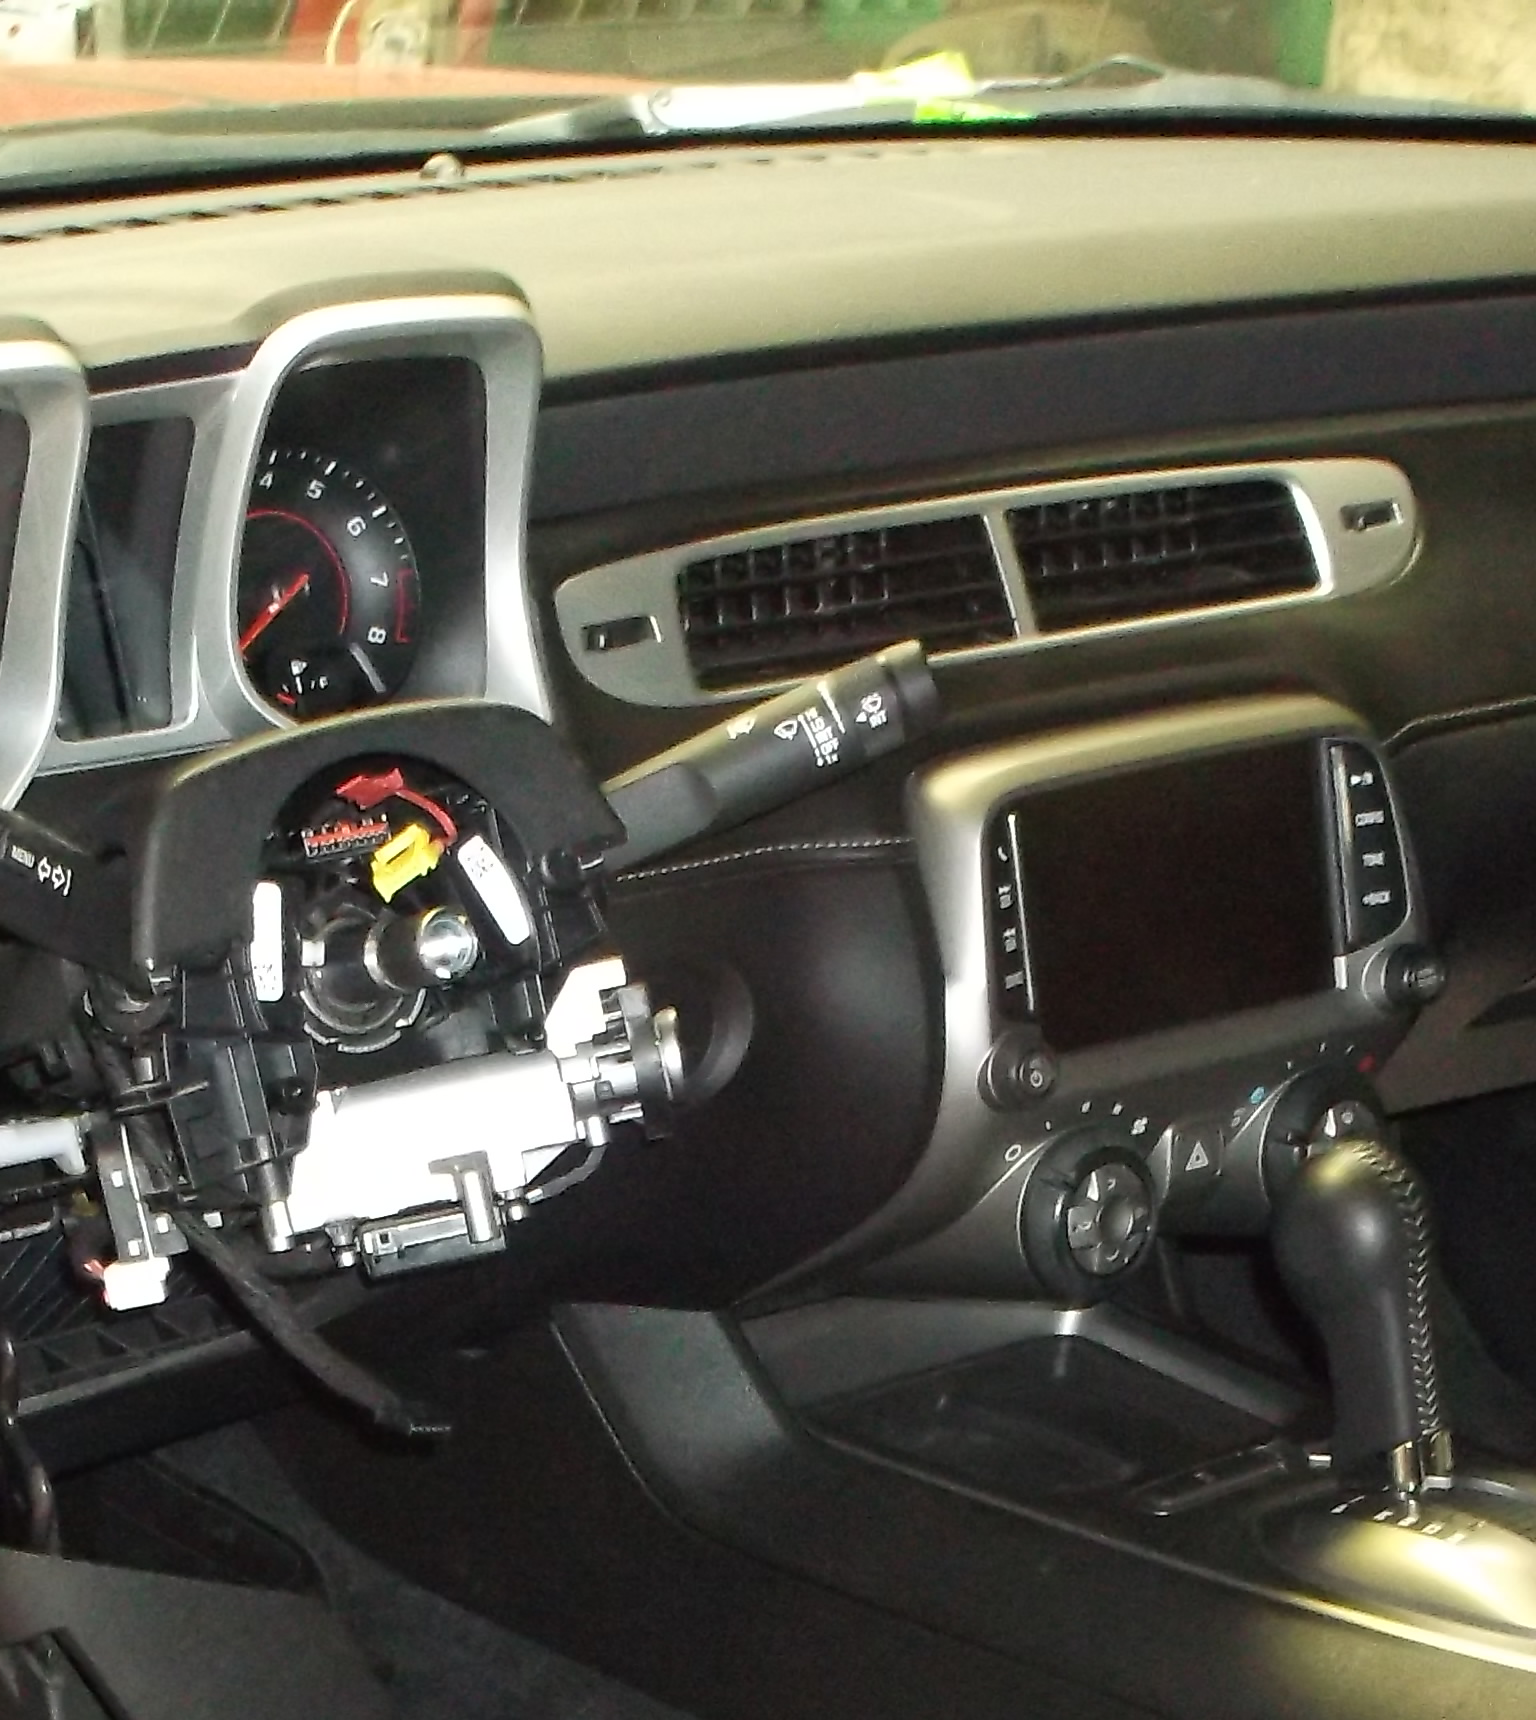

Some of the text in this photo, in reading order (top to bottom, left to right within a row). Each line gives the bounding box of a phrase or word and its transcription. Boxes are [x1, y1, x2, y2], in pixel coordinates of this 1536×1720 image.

[259, 471, 273, 489] 4
[306, 480, 326, 500] 5
[346, 516, 367, 537] 6
[370, 571, 390, 588] 7
[367, 626, 387, 645] 8
[819, 737, 840, 755] OFF
[11, 844, 35, 869] MENU
